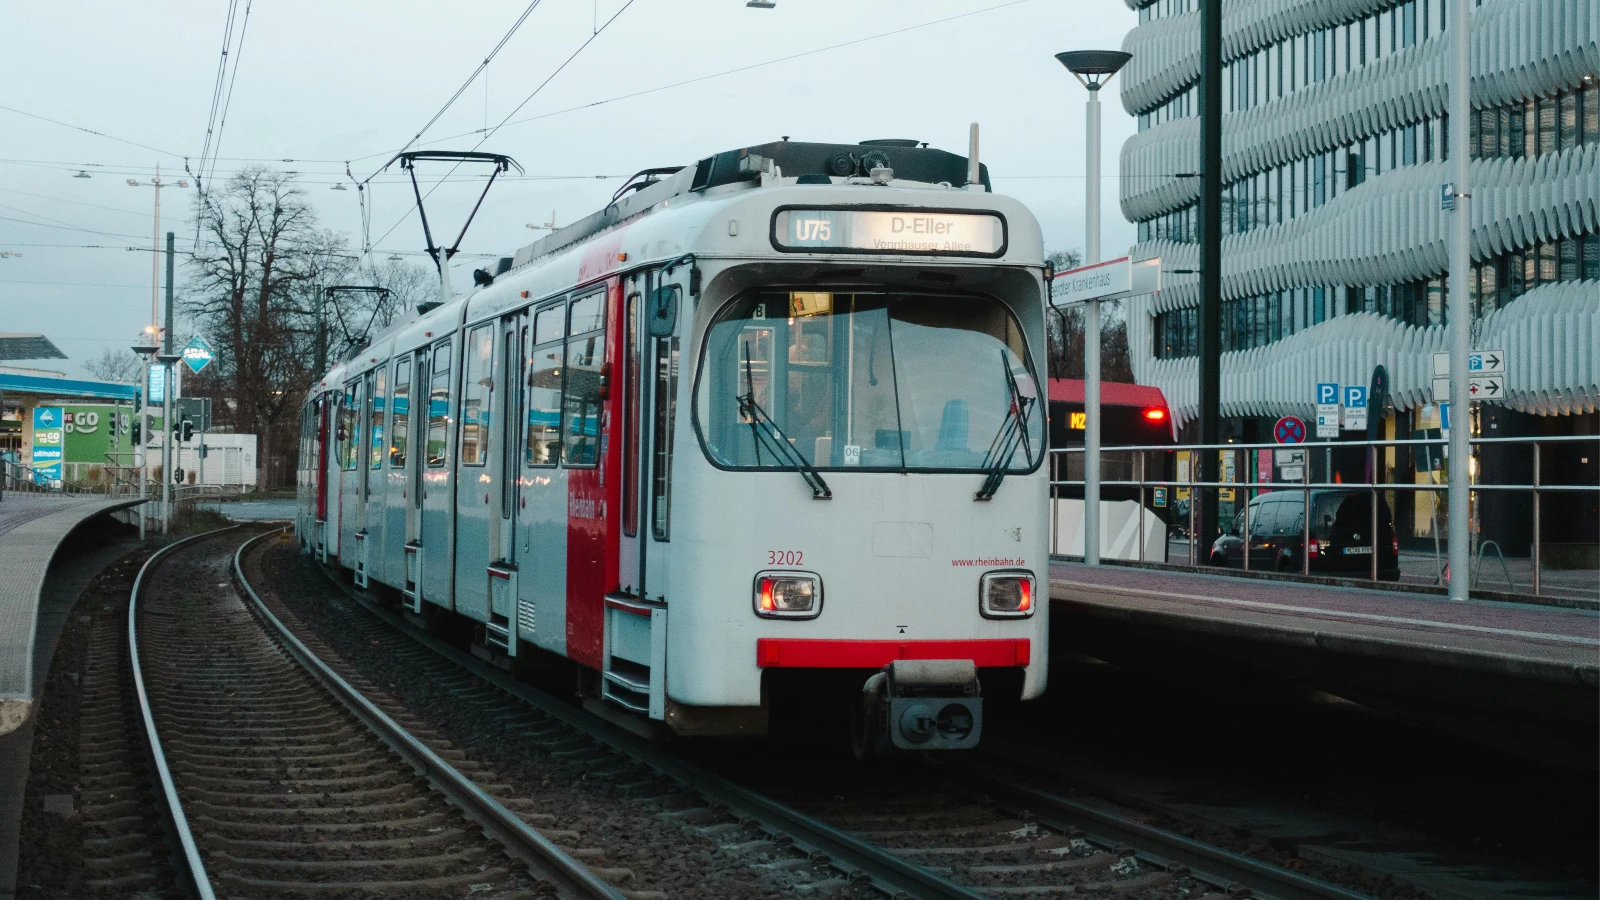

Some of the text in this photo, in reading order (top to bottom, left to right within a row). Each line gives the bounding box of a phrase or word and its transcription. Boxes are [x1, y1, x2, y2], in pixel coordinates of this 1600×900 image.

[796, 217, 954, 241] U75 D-Eller
[873, 238, 971, 252] Vennhauser Allee
[1072, 272, 1111, 292] Krankenhaus
[1321, 385, 1334, 404] P
[1350, 388, 1362, 407] P
[75, 412, 99, 426] GO
[47, 432, 60, 440] GO
[845, 447, 859, 456] 06
[569, 490, 595, 519] Rheinbahn
[767, 550, 1026, 567] 3202 www.rheinbahn.de
